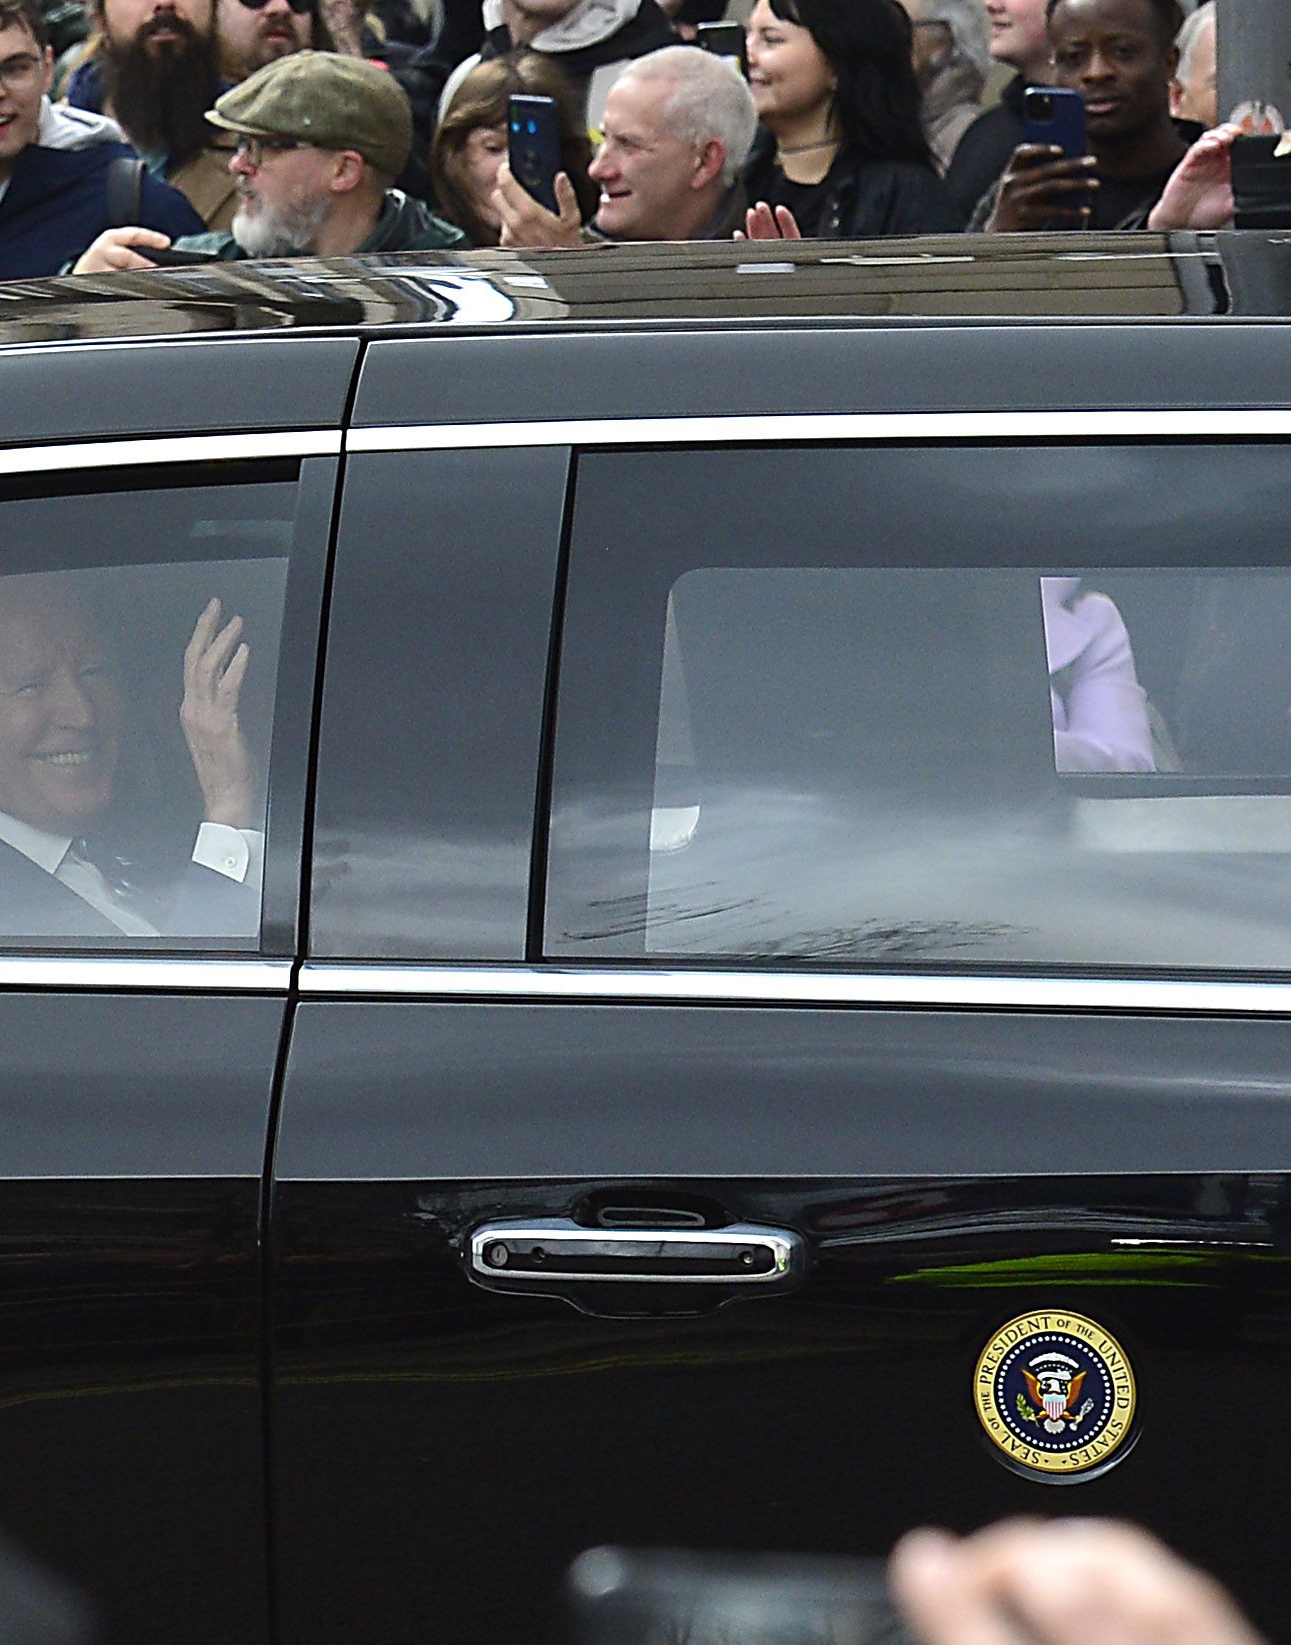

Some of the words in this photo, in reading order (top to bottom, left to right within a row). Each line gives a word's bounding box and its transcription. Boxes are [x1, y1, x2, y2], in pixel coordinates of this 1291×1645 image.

[1056, 1318, 1071, 1329] OF
[1076, 1323, 1095, 1340] THE
[979, 1316, 1051, 1385] PRESIDENT
[1098, 1340, 1130, 1409] UNITED
[981, 1391, 992, 1411] THE
[988, 1417, 1000, 1431] OF
[999, 1431, 1041, 1464] SEAL
[1069, 1418, 1123, 1466] STATES
